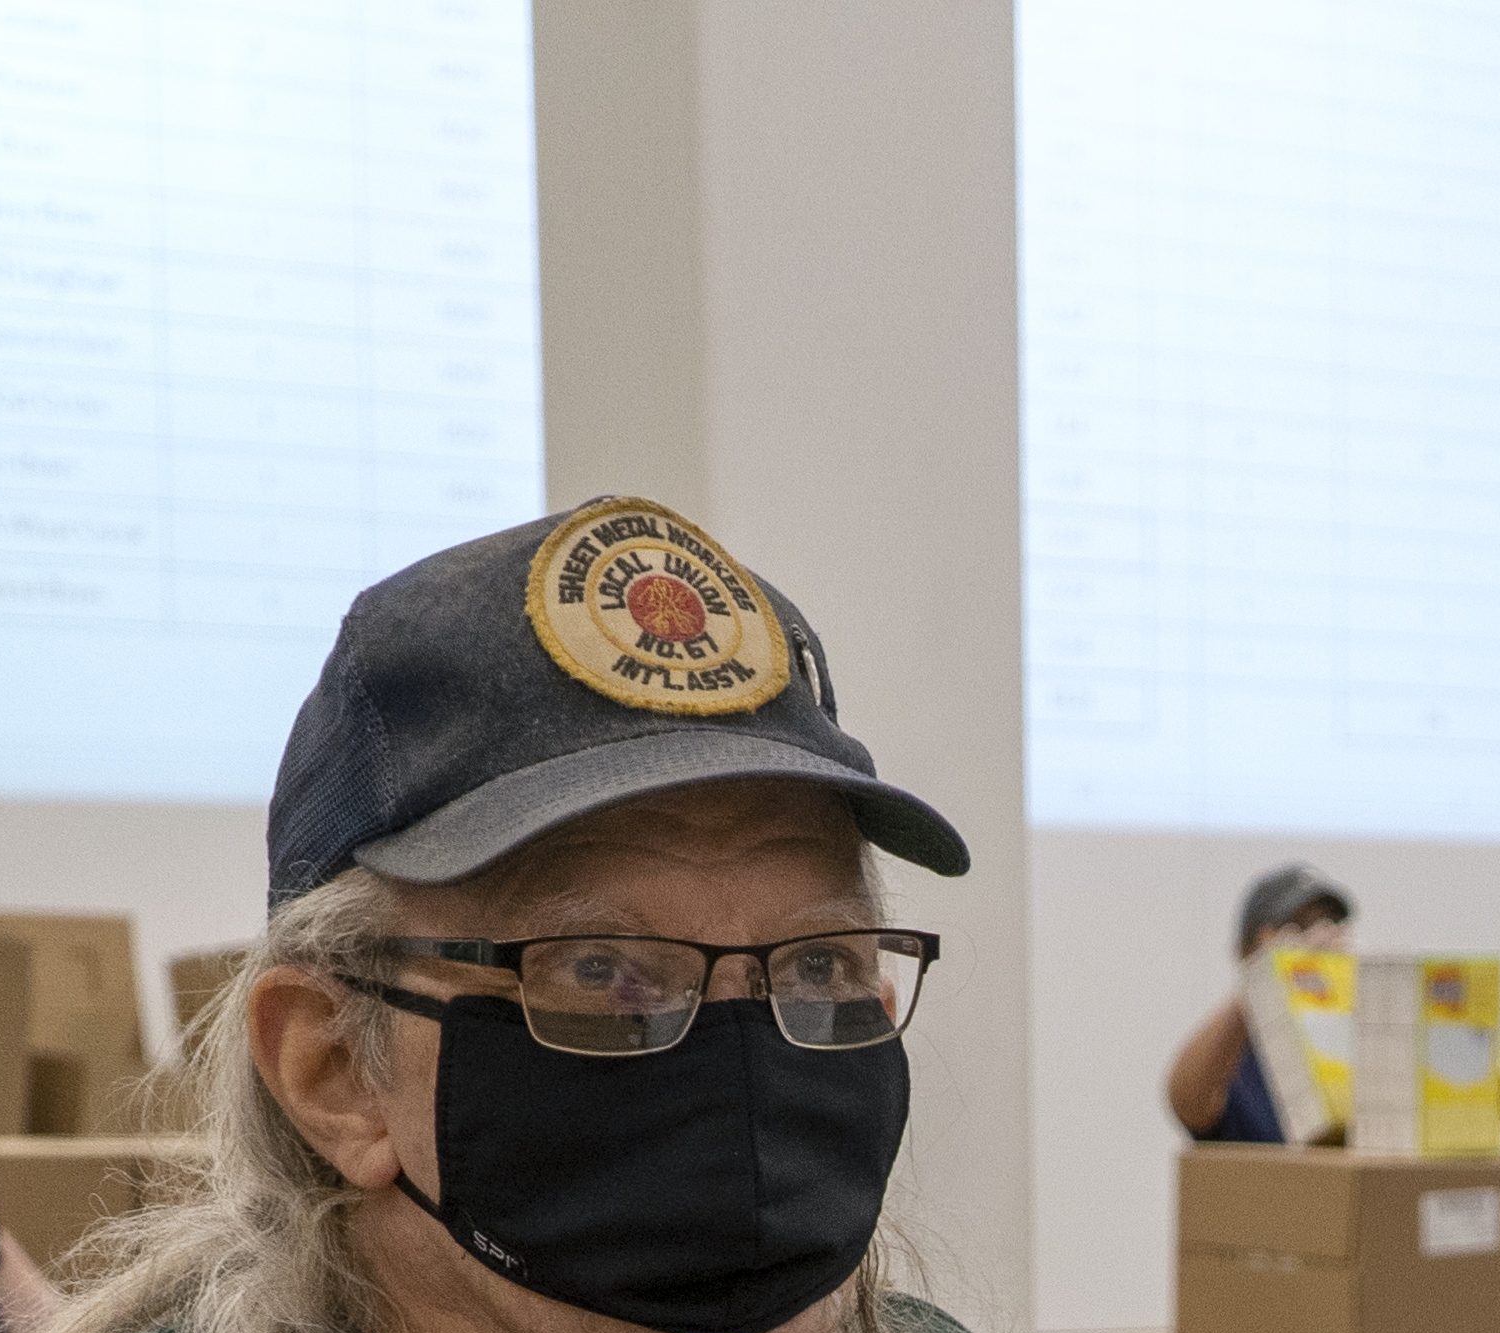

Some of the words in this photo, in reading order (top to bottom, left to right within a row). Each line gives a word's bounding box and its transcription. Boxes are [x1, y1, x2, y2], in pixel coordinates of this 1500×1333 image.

[558, 536, 601, 604] SHEET
[591, 515, 665, 547] METAL
[666, 522, 757, 613] WORKERS
[599, 551, 653, 610] LOCAL
[664, 553, 731, 616] UNION
[635, 630, 683, 659] NO.
[683, 631, 719, 660] 67
